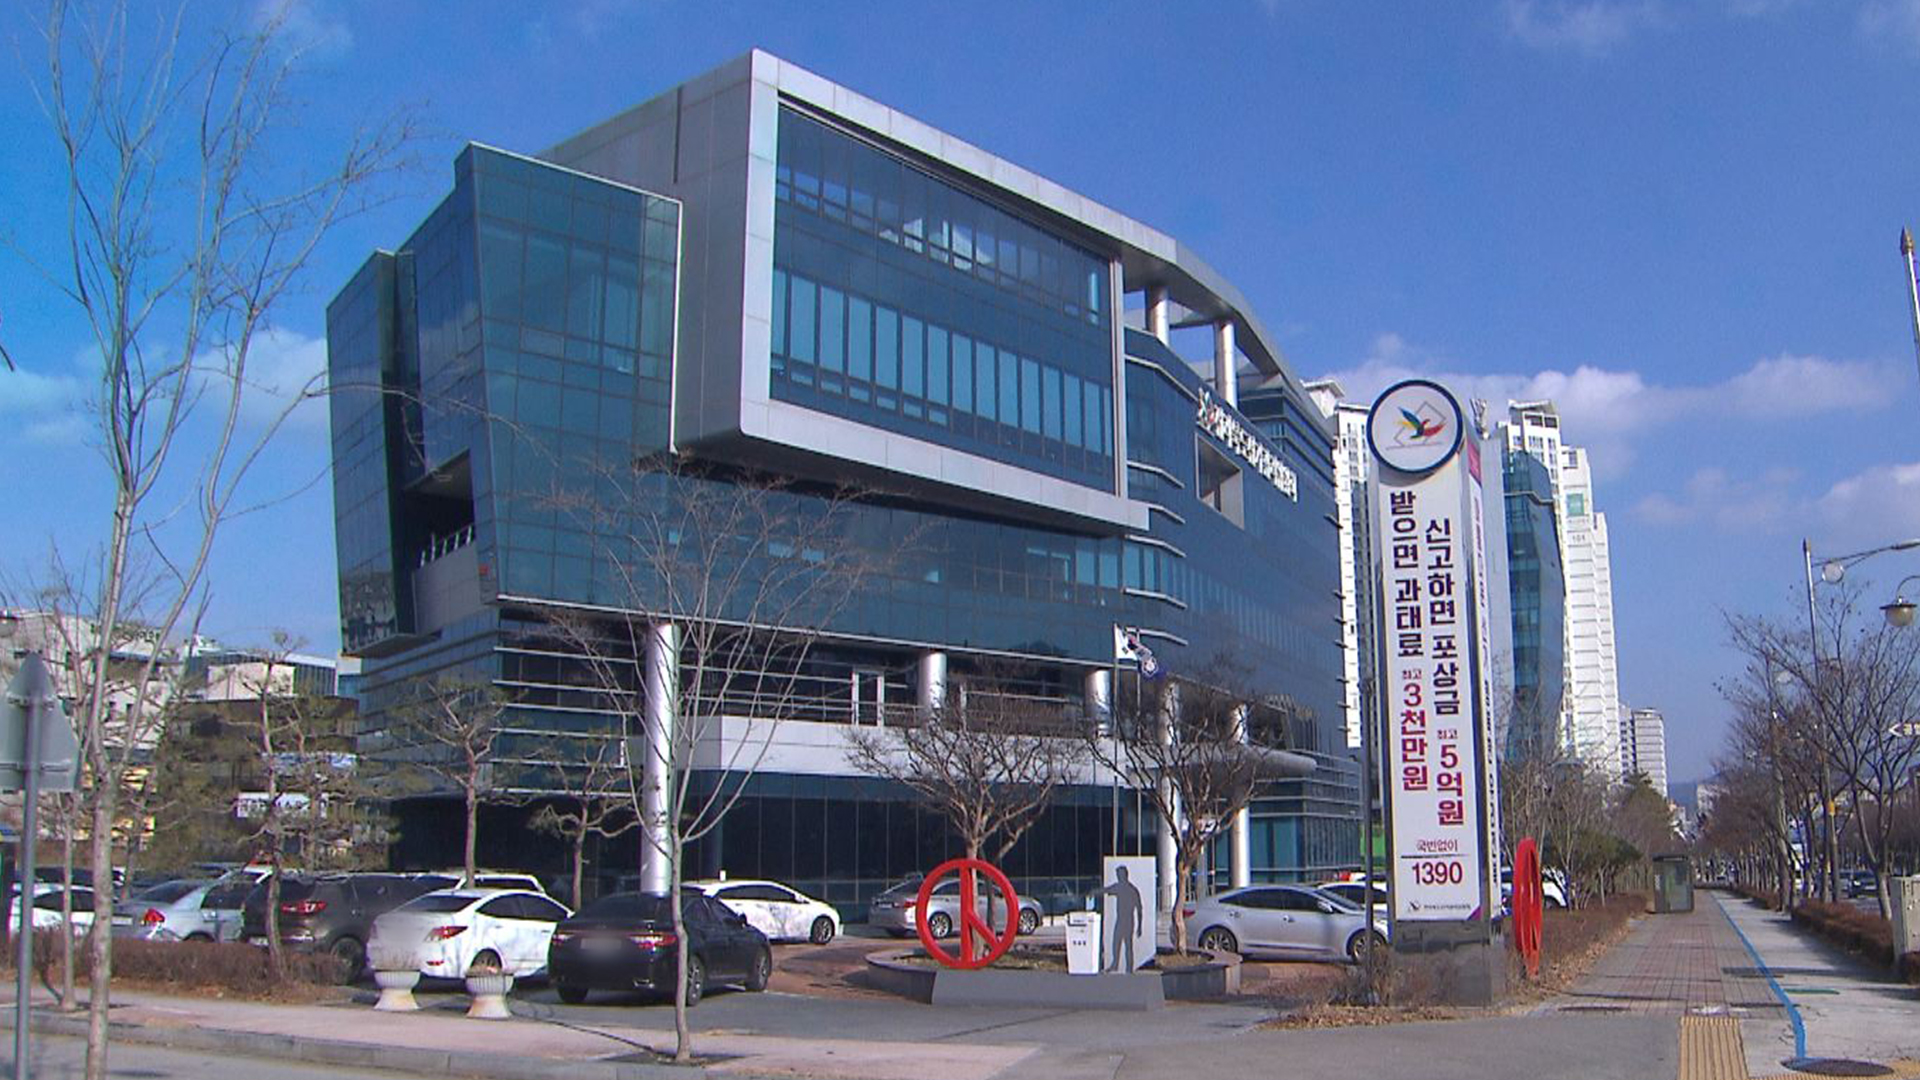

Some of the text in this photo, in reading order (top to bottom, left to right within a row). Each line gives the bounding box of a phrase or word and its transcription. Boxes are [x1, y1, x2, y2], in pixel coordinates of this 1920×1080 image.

[1390, 491, 1418, 569] 받으면
[1426, 518, 1456, 626] 신고하면
[1395, 578, 1424, 657] 과태료
[1432, 635, 1460, 715] 포상금
[1400, 682, 1428, 791] 3천만원
[1436, 744, 1464, 826] 5억원
[1411, 861, 1464, 885] 1390
